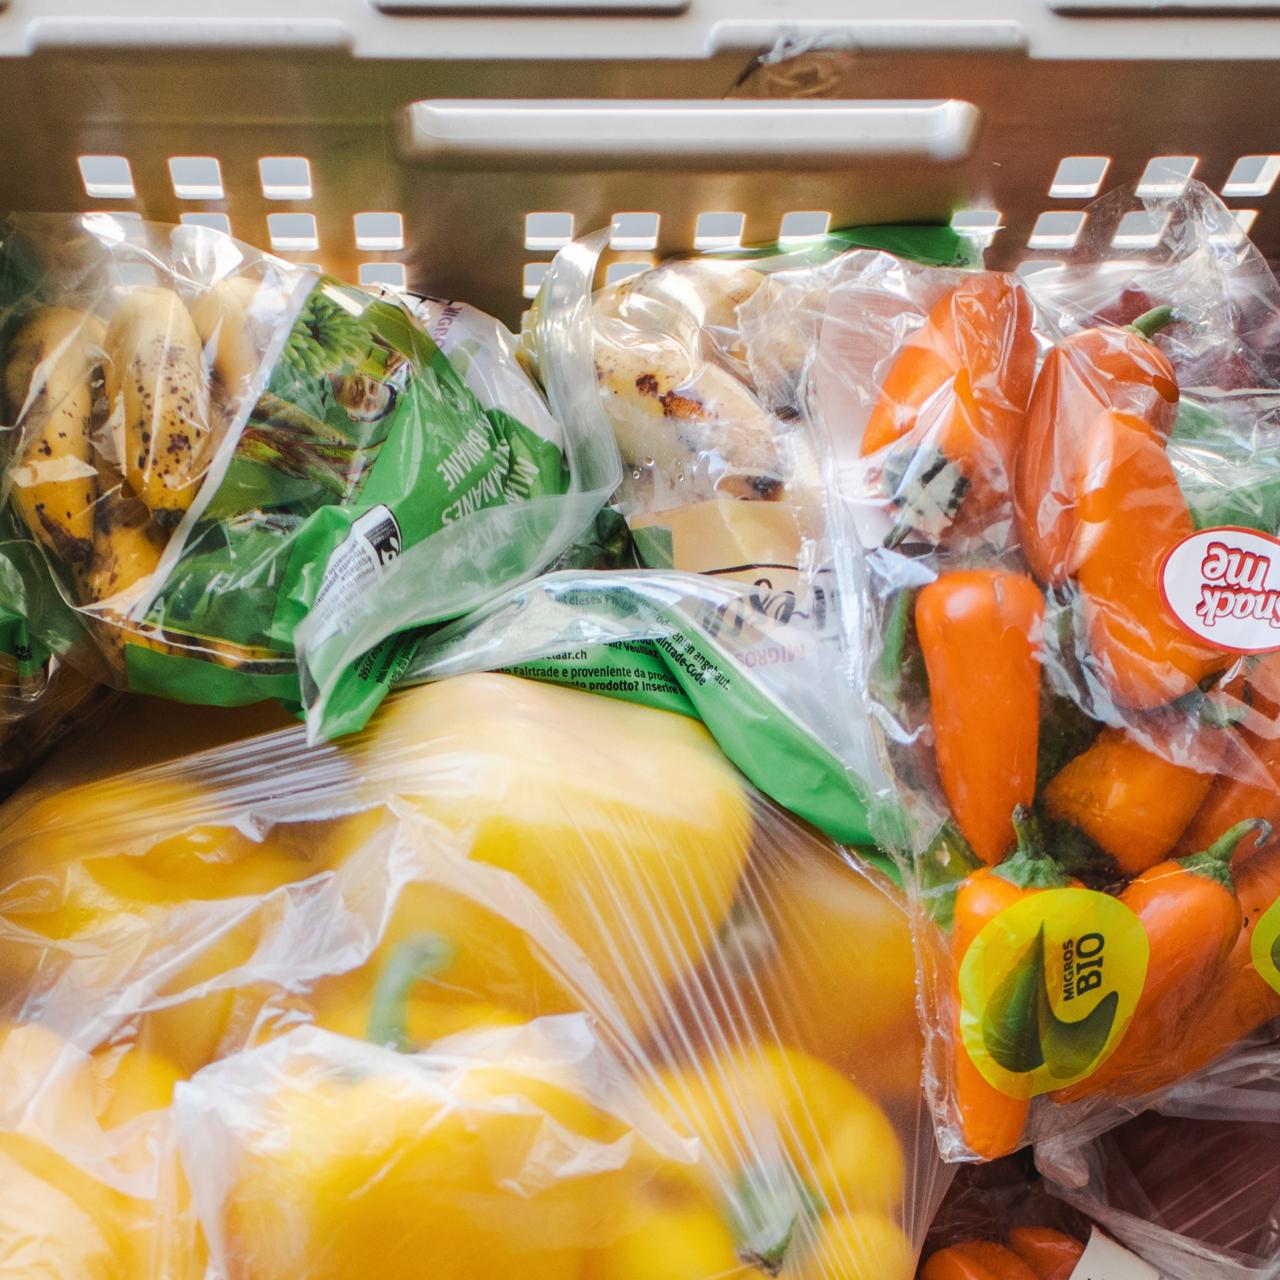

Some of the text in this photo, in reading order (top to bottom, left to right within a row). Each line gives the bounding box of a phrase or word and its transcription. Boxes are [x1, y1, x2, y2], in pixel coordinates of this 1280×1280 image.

[1201, 542, 1270, 591] me
[655, 633, 708, 686] airtrade-Code
[671, 631, 696, 655] enten
[513, 666, 645, 680] Fairtrade e proveniente da
[589, 681, 638, 691] prodotto?
[1063, 939, 1073, 1001] MIGROS
[1076, 933, 1105, 995] BIO
